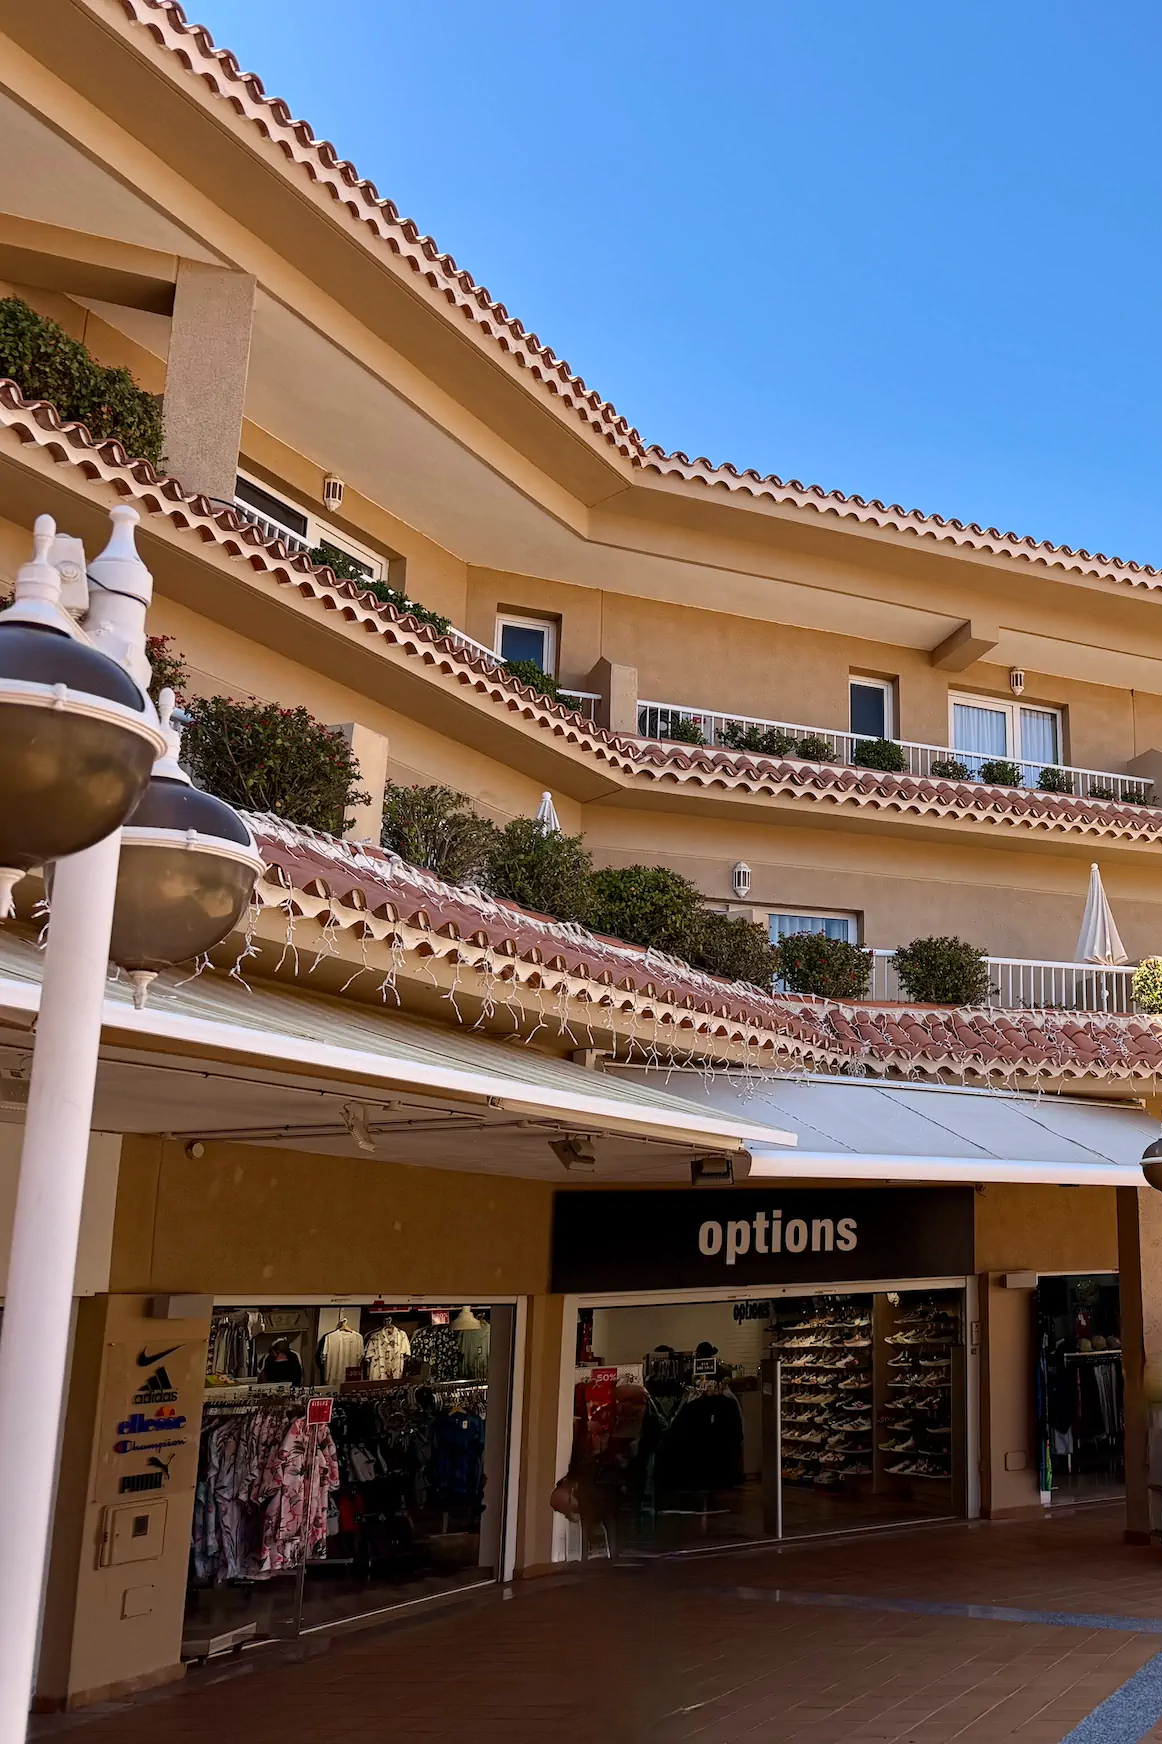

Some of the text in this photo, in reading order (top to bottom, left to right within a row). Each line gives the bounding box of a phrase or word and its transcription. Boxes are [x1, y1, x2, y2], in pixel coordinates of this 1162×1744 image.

[699, 1209, 858, 1265] options
[133, 1390, 178, 1404] adidas
[119, 1472, 164, 1494] PUMA
